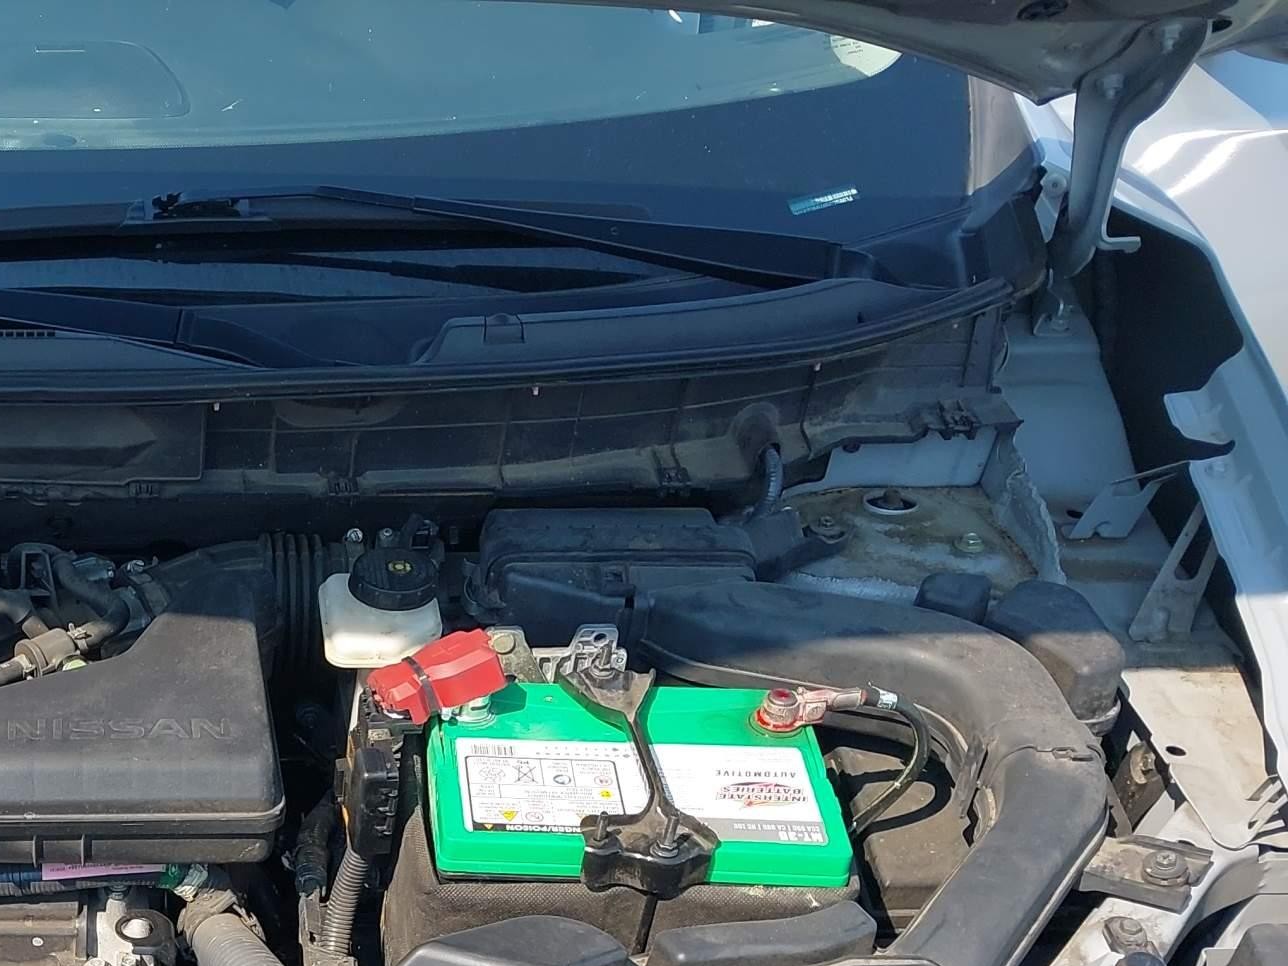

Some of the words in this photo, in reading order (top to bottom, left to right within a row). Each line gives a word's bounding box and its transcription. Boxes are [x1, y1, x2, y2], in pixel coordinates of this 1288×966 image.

[7, 718, 237, 740] NISSAN
[715, 769, 796, 778] AUTOMOTIVE
[722, 786, 801, 794] BATTERIES
[719, 793, 807, 802] INTERSTATE
[506, 824, 582, 833] NGER/POISON
